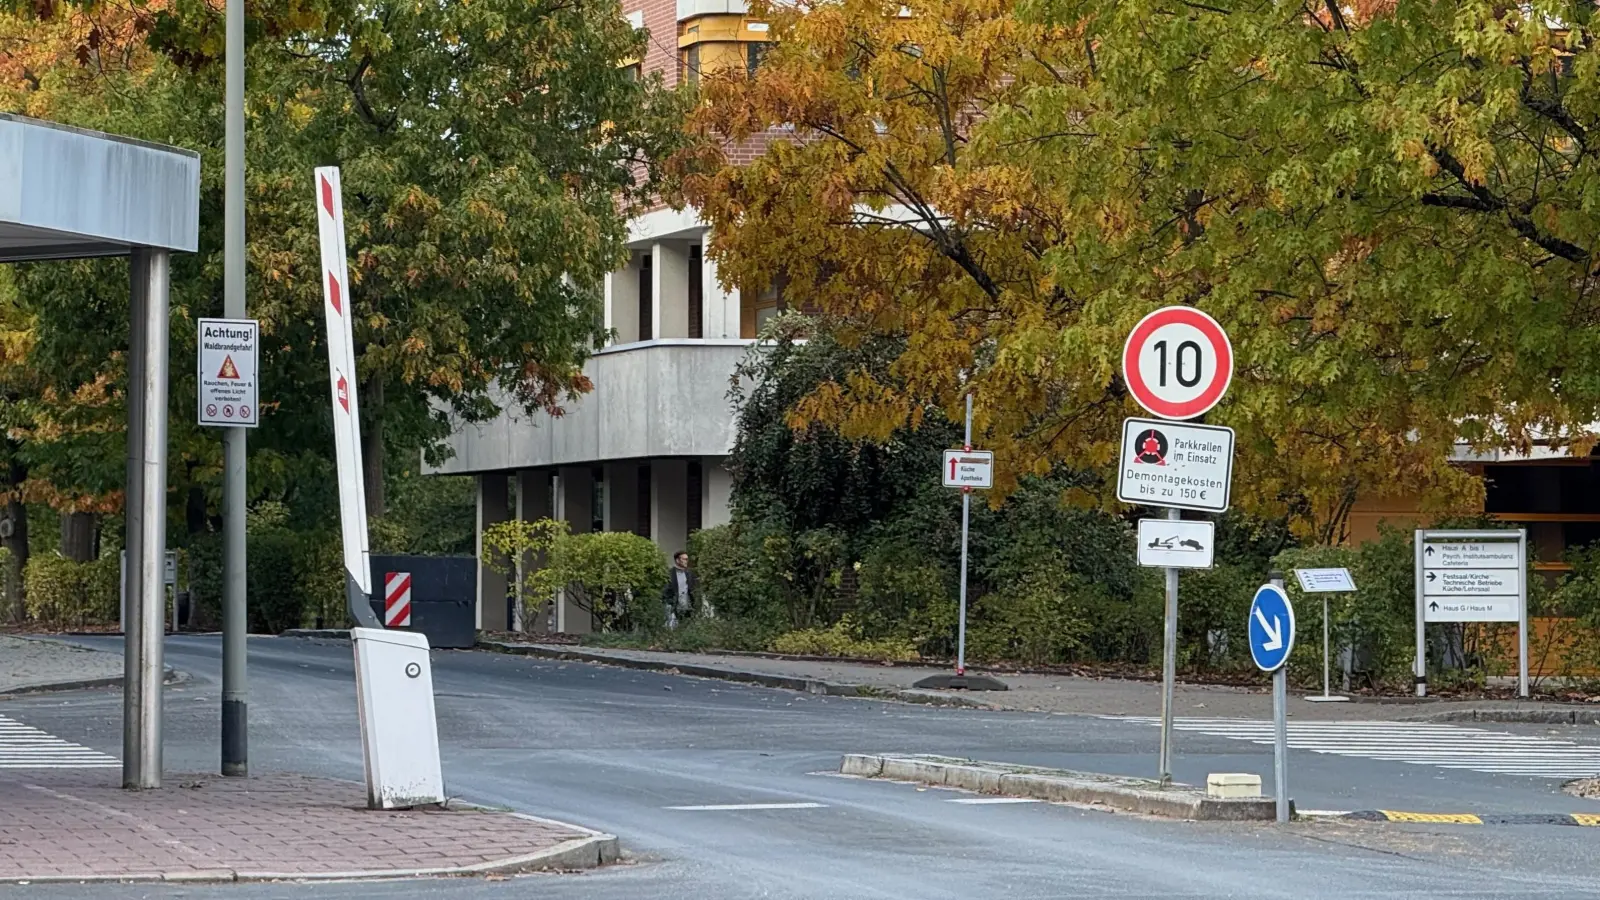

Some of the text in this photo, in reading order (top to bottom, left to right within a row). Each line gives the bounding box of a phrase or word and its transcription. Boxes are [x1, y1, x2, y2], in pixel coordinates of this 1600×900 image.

[204, 326, 252, 341] Achtung!
[204, 342, 252, 352] Waldbrandgefahr!
[1153, 340, 1202, 388] 10
[1174, 438, 1222, 453] Parkkrallen
[1173, 451, 1217, 465] im Einsatz
[1126, 469, 1223, 489] Demontagekosten
[1139, 484, 1156, 495] bis
[1161, 488, 1174, 497] zu
[1180, 488, 1197, 499] 150
